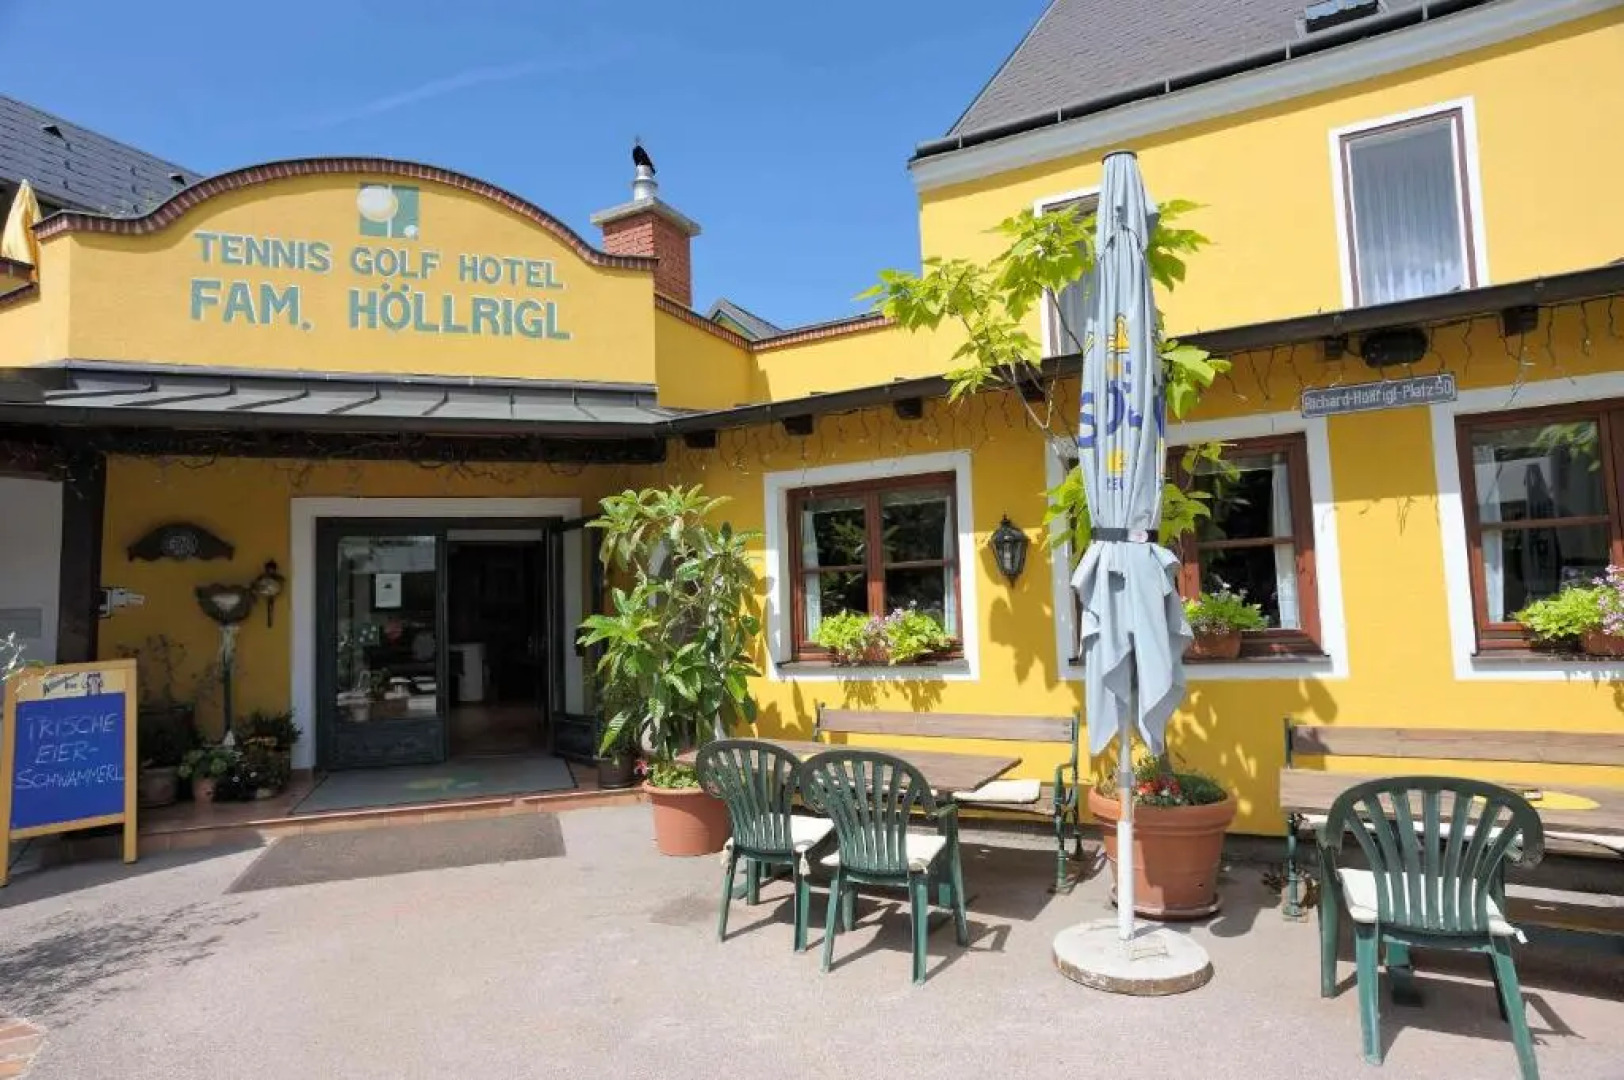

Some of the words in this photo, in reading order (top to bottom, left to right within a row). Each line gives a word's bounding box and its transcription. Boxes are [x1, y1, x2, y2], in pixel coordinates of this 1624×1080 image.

[194, 231, 331, 273] TENNIS
[350, 246, 440, 280] GOLF
[459, 254, 563, 289] HOTEL
[190, 279, 312, 331] FAM.
[349, 282, 571, 340] HÖLLRIGL
